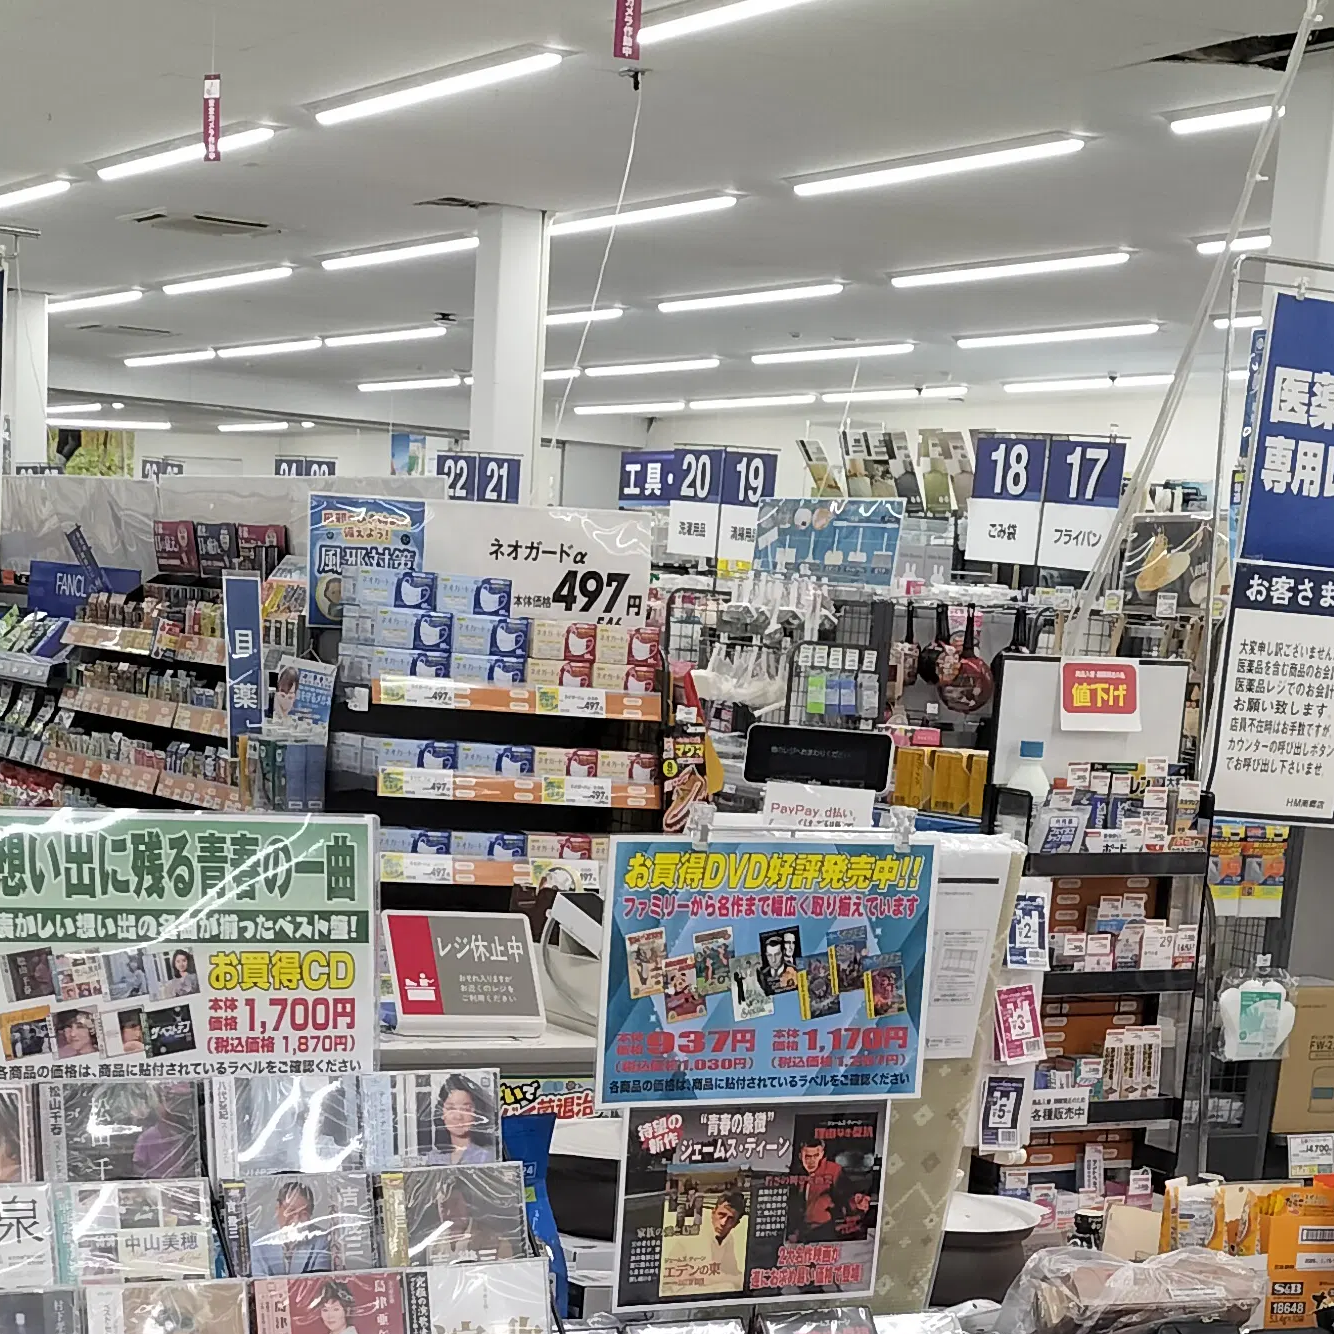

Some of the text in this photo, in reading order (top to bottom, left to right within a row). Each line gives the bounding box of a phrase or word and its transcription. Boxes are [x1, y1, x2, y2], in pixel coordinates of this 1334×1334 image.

[443, 459, 467, 496] 22
[485, 461, 509, 499] 21
[680, 453, 711, 498] 20
[736, 456, 764, 503] 19
[990, 443, 1028, 497] 18
[1065, 446, 1111, 501] 17
[988, 523, 1017, 542] ごみ袋
[1054, 528, 1102, 548] フライパン
[488, 537, 588, 565] ネオガードα
[55, 572, 87, 598] FANCL
[513, 594, 552, 610] 本体価格
[1071, 682, 1128, 707] 値下げ
[770, 802, 820, 818] PayPay
[624, 852, 922, 891] お買得DVD好評発売中!!
[622, 894, 920, 919] ファミリーから名作まで幅広く取り揃えています
[436, 934, 524, 963] レジ休止中
[208, 951, 356, 991] お買得CD
[208, 998, 238, 1013] 本体
[246, 998, 356, 1034] 1,700円
[208, 1016, 238, 1032] 価格
[609, 1072, 910, 1094] 各商品の価格は、商品に貼付されているラベルをご確認ください
[647, 1133, 680, 1155] 新作
[124, 1232, 200, 1252] 中山美穂
[1272, 1283, 1303, 1295] S&B
[1272, 1302, 1305, 1314] 18648
